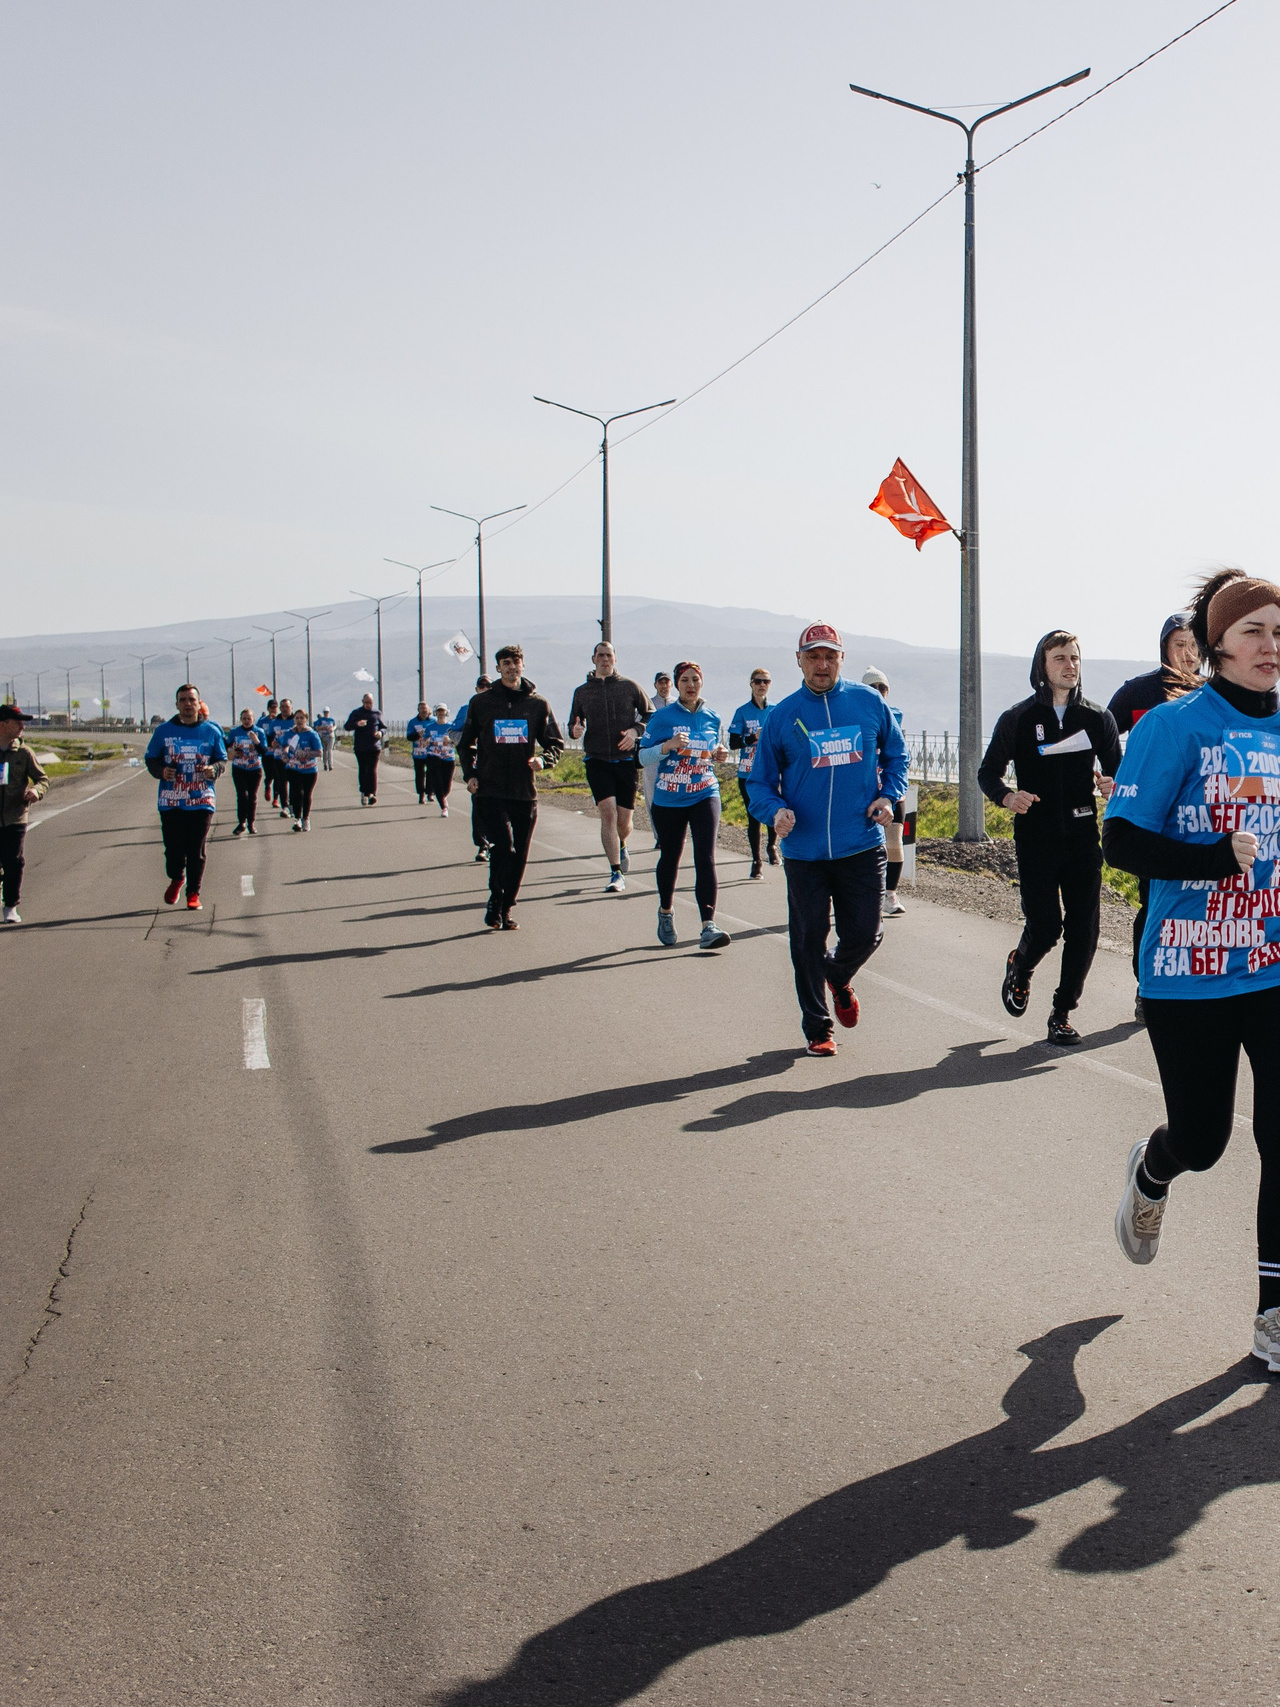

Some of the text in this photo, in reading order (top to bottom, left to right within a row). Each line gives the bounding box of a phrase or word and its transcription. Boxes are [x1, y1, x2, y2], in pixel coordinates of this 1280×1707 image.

[821, 738, 852, 754] 30015
[828, 753, 850, 766] 10КМ
[1160, 919, 1266, 948] #ЛЮБОВЬ
[1153, 948, 1230, 977] #ЗАБЕГ
